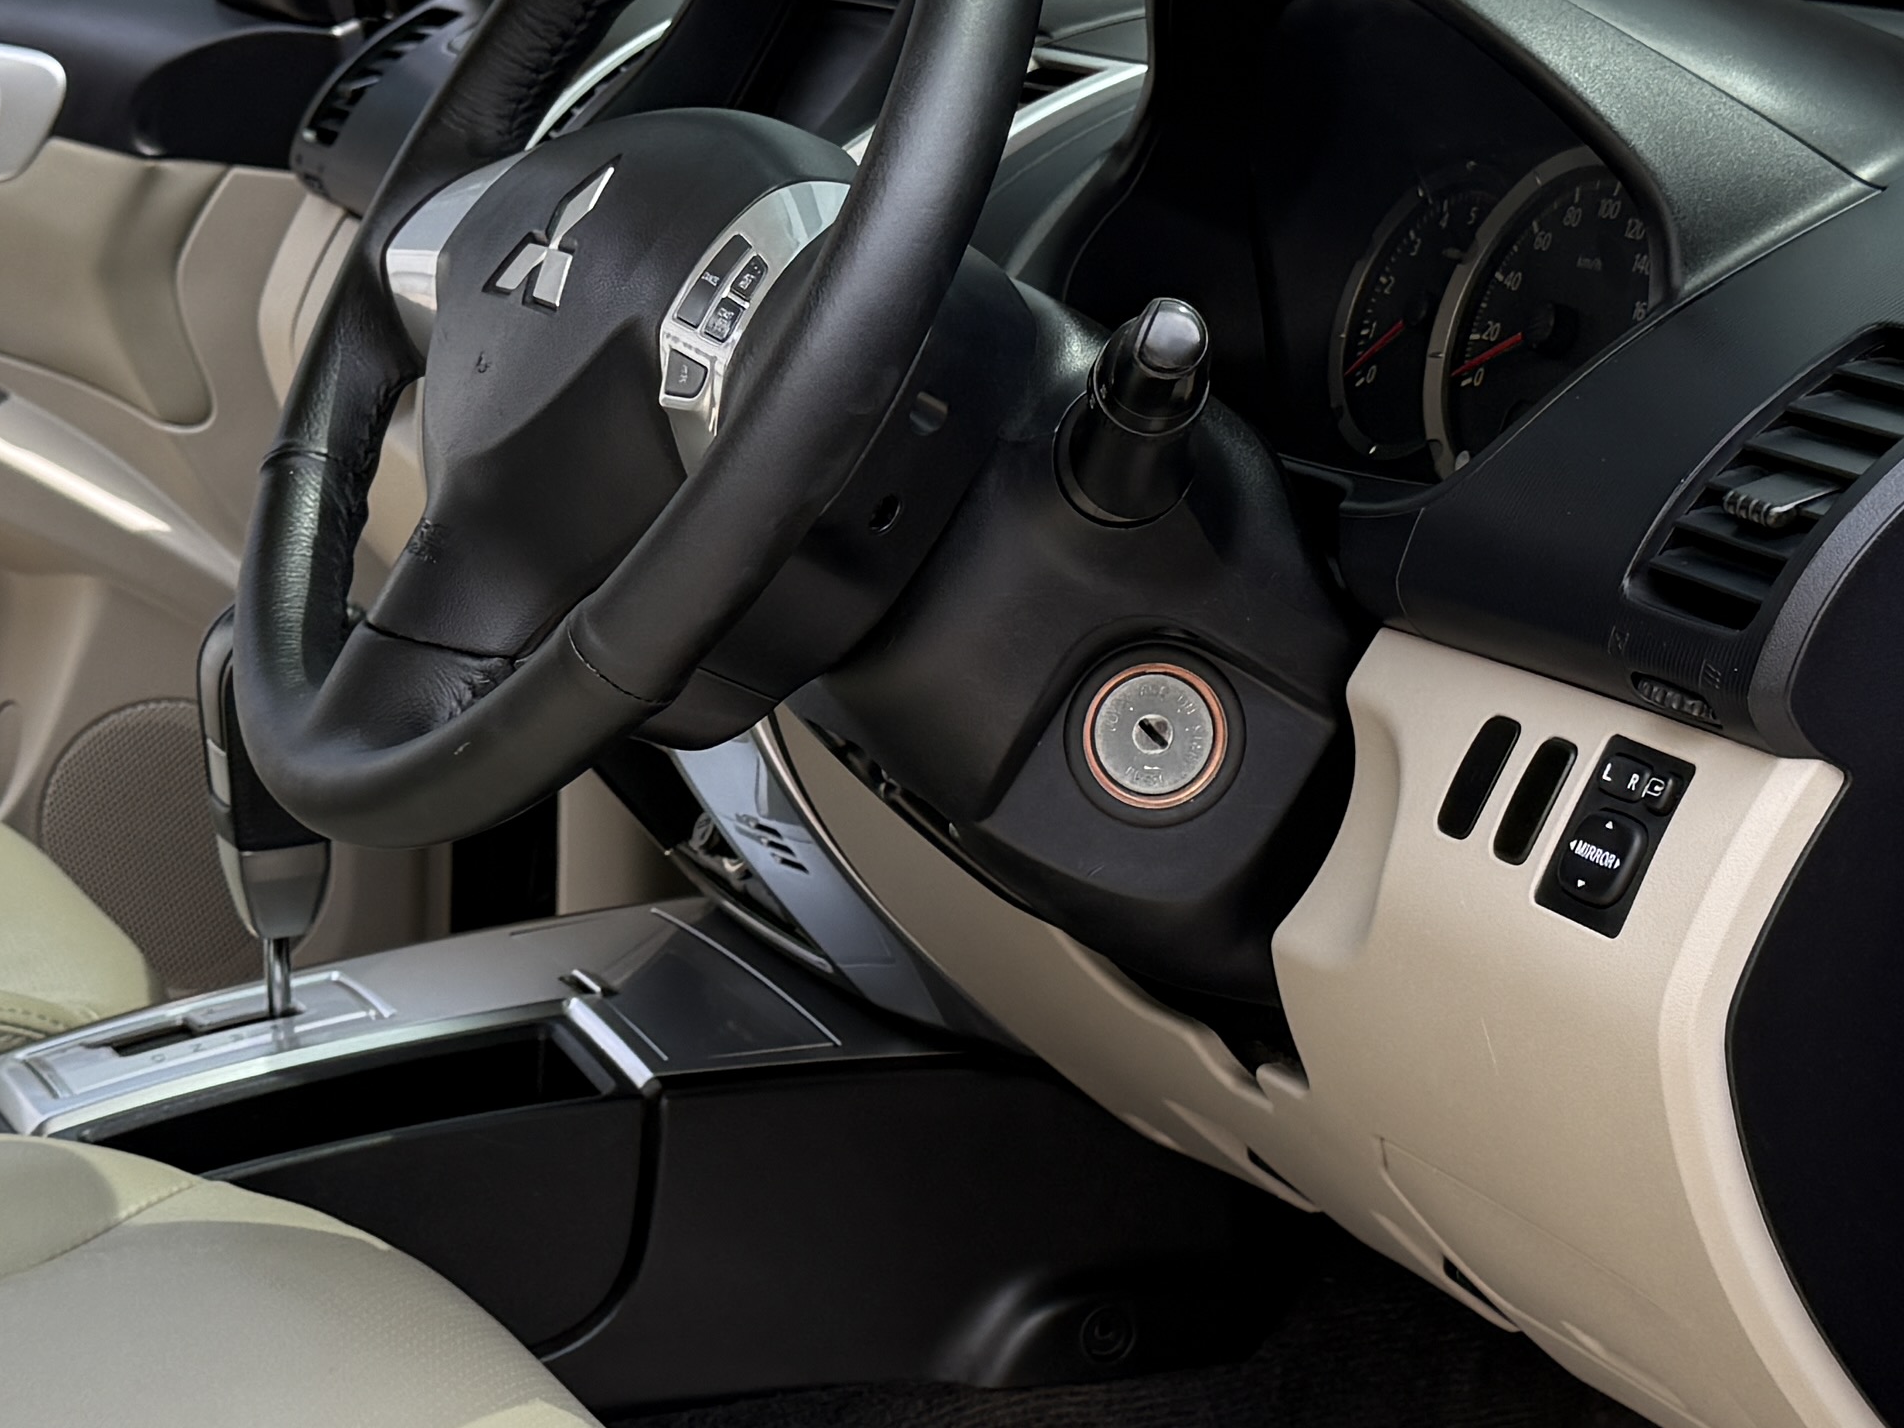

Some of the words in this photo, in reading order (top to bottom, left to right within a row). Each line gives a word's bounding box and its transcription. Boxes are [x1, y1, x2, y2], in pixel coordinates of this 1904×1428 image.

[1562, 206, 1583, 227] 80
[1598, 199, 1623, 220] 100
[1533, 231, 1553, 252] 60
[1383, 277, 1394, 295] 2
[1503, 271, 1523, 292] 40
[1631, 301, 1647, 321] 16
[1482, 320, 1502, 341] 20
[1366, 364, 1378, 385] 0
[1472, 367, 1485, 387] 0
[1601, 762, 1612, 782] L
[1626, 773, 1640, 791] R
[1574, 839, 1616, 869] MIRROR
